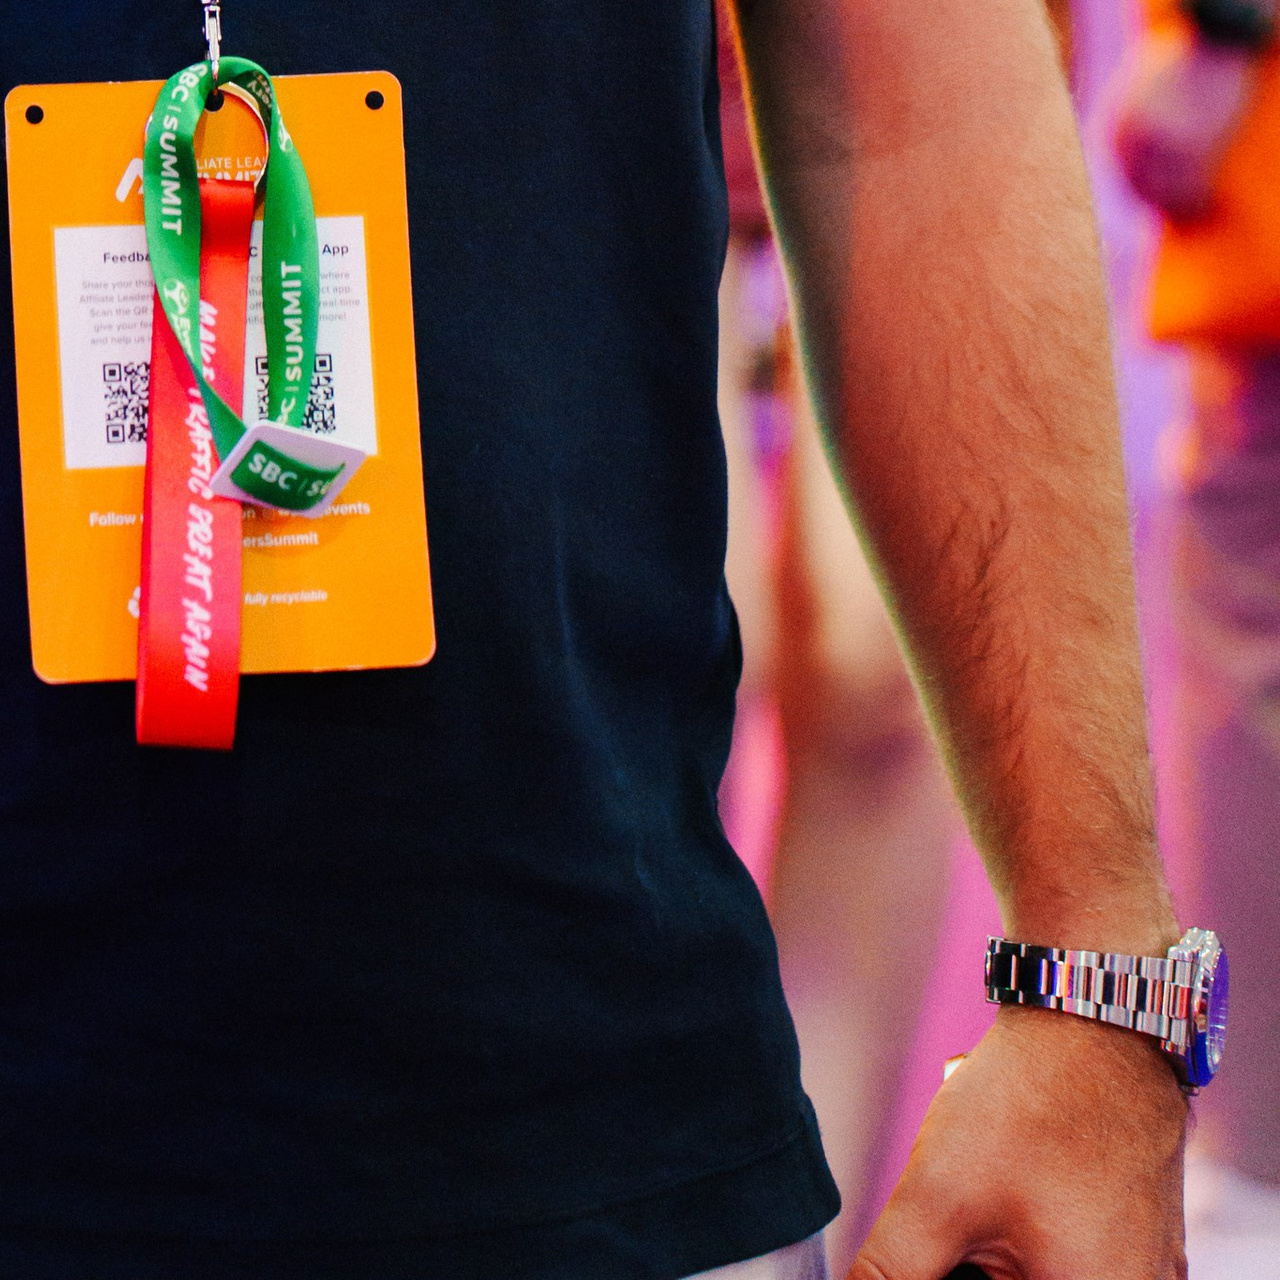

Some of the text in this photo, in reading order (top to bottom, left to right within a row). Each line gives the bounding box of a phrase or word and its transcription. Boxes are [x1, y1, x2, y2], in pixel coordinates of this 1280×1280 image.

[159, 63, 208, 236] SBC SUMMIT
[102, 251, 152, 263] Feedba
[322, 243, 349, 257] App
[133, 305, 148, 316] QR
[281, 260, 303, 383] SUMMIT
[248, 452, 298, 490] SBC
[89, 511, 136, 527] Follow
[243, 530, 319, 547] ersSummit
[183, 503, 214, 602] GREAT
[244, 592, 268, 606] fully
[181, 598, 212, 693] AGAIN
